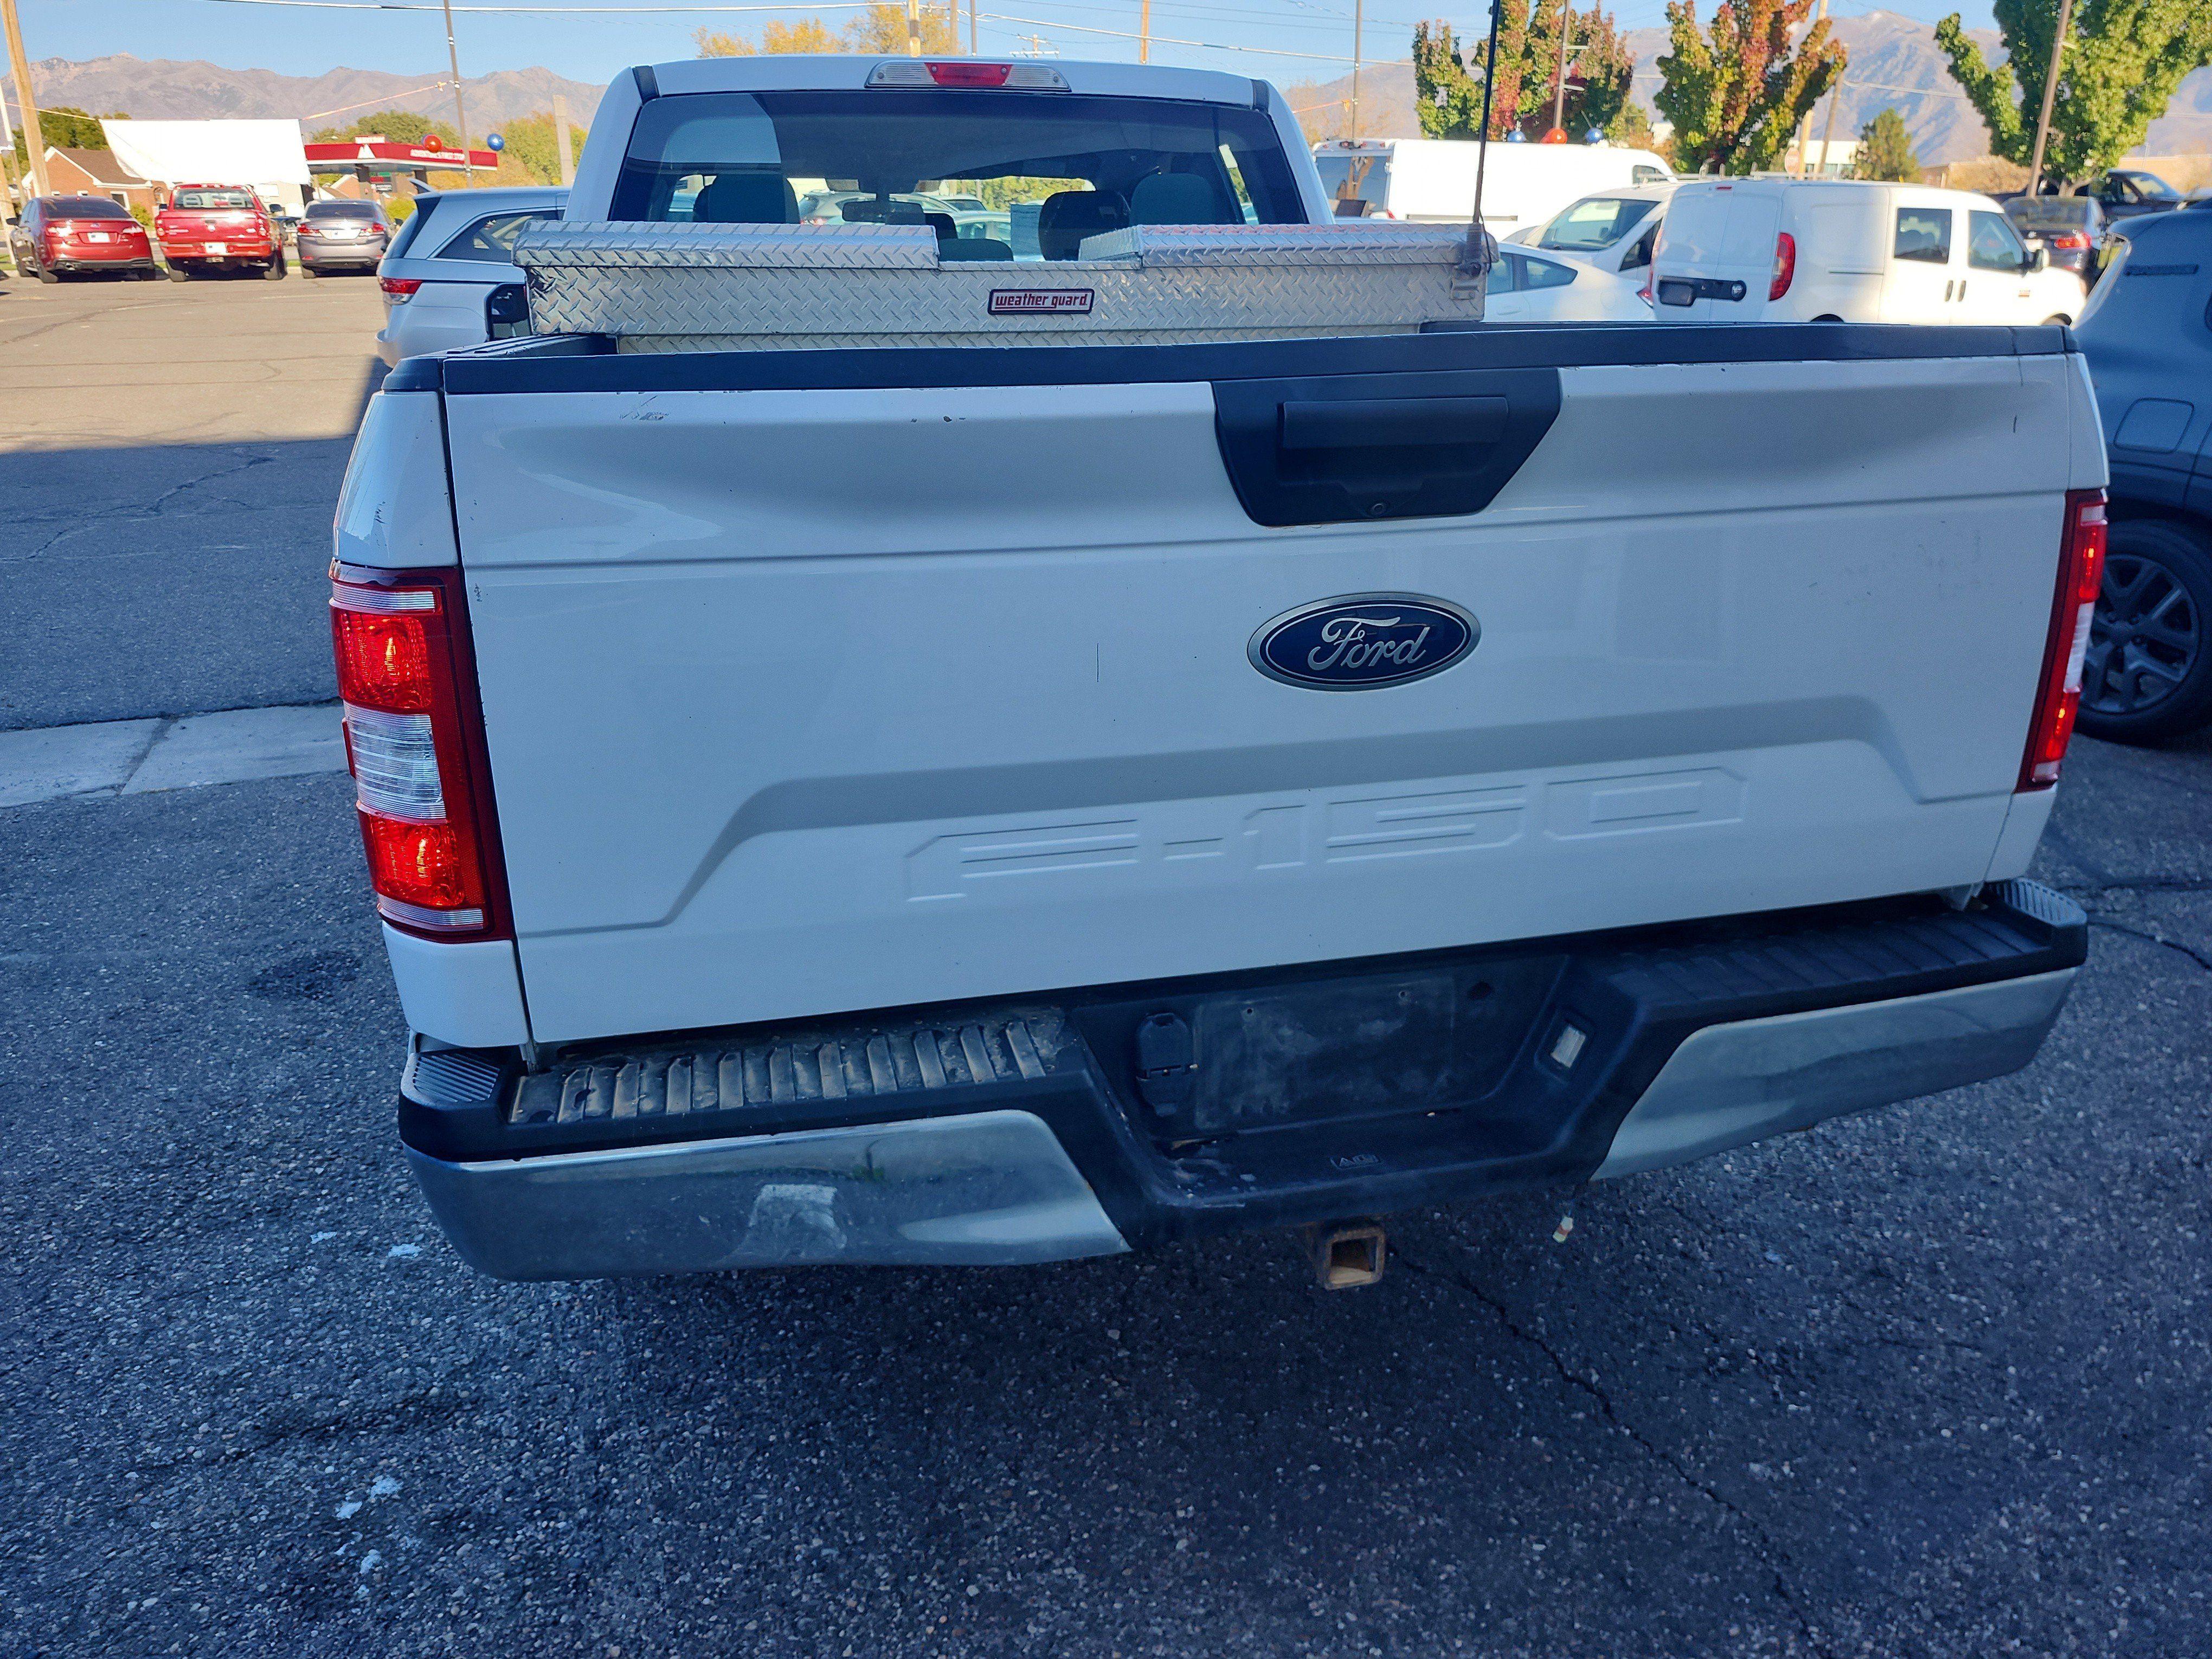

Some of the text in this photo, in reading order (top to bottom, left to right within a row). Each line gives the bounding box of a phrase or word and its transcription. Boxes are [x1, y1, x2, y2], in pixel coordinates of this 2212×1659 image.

[995, 293, 1087, 308] weather guard
[1307, 616, 1430, 671] Ford
[904, 766, 1748, 902] F-150
